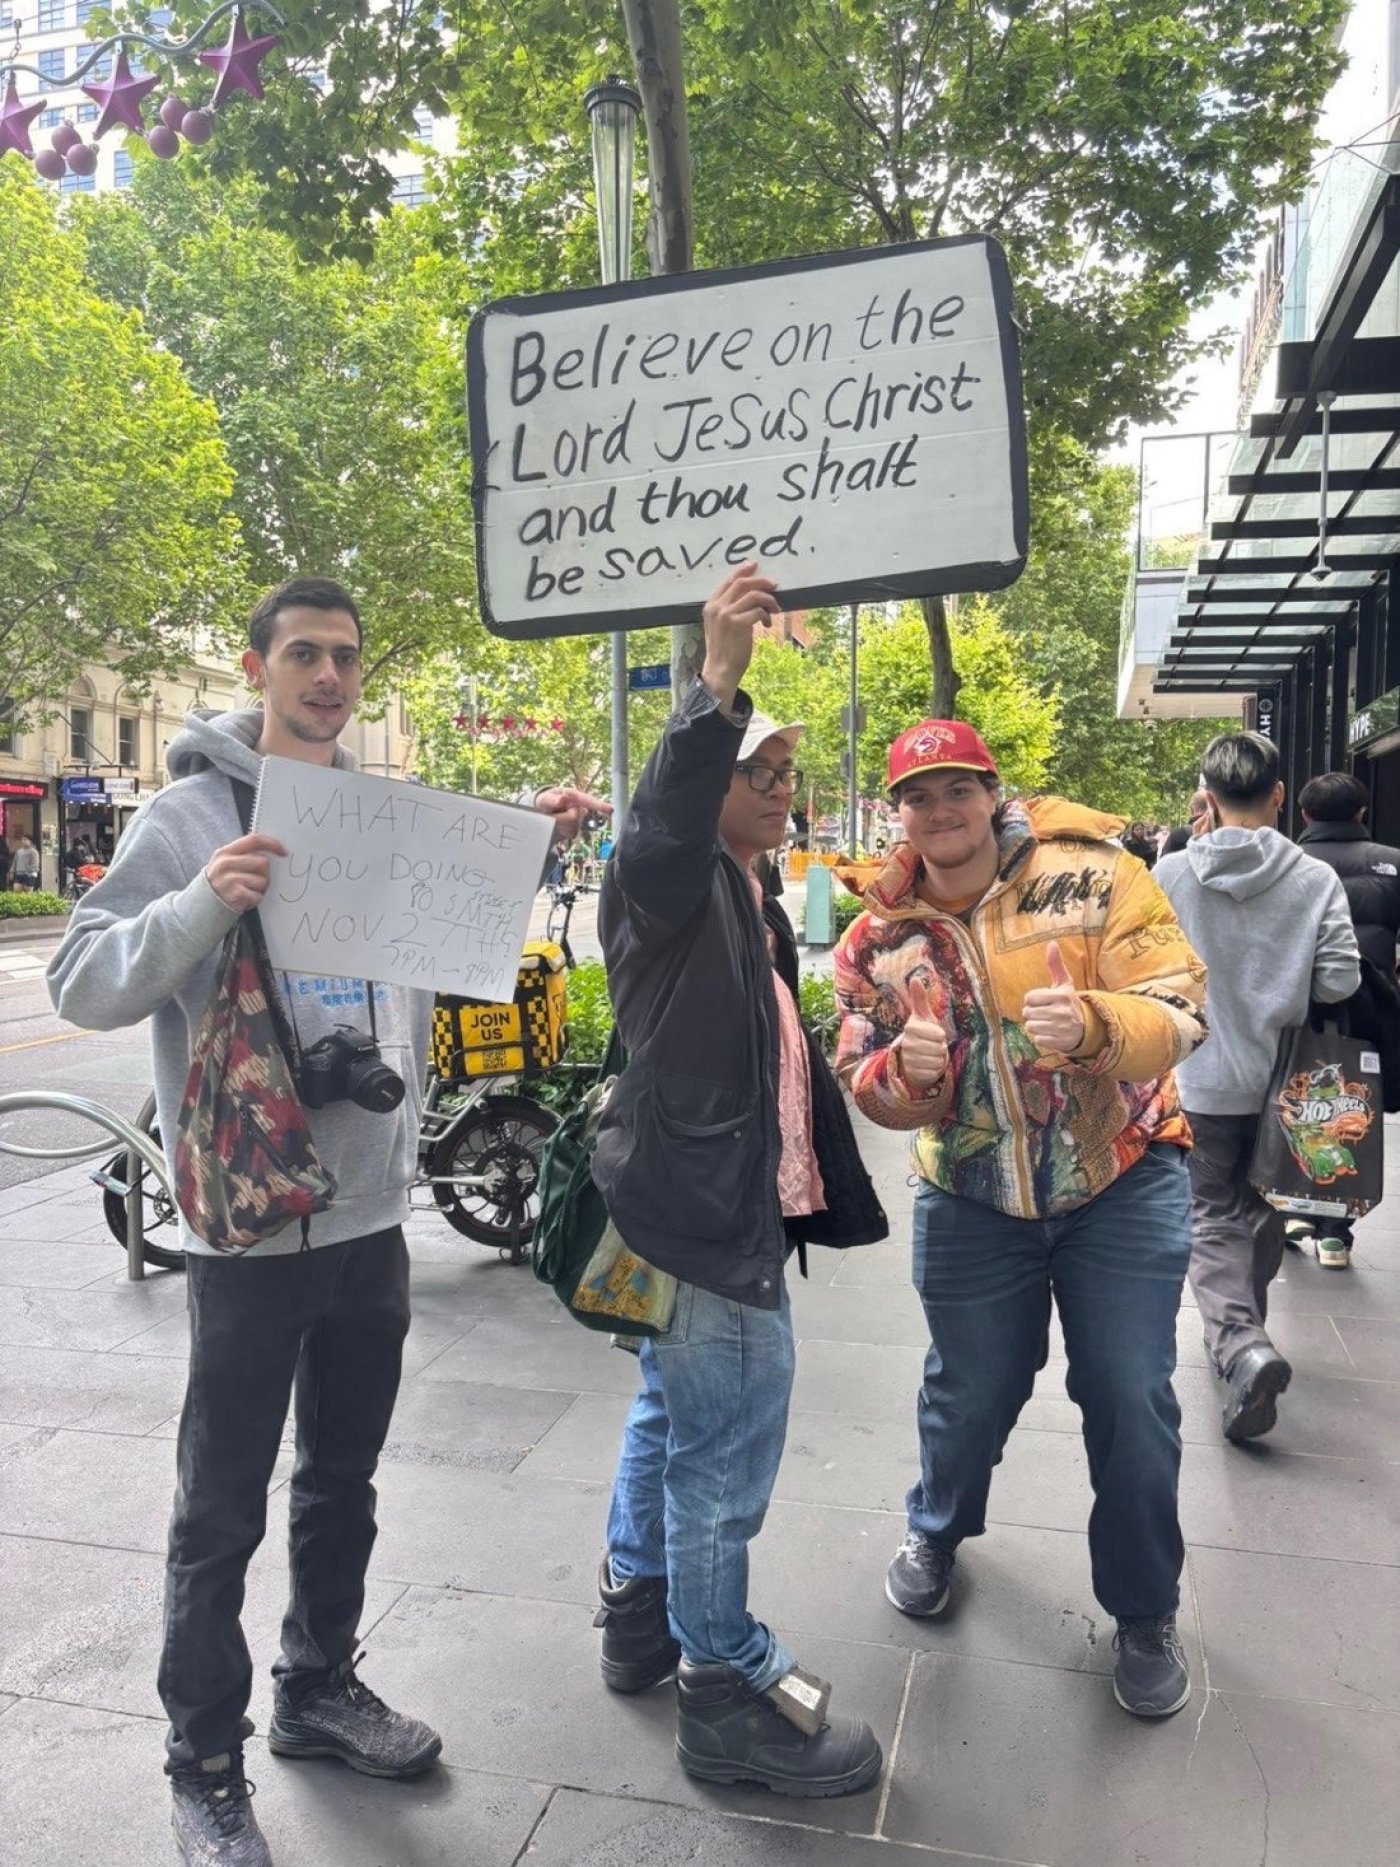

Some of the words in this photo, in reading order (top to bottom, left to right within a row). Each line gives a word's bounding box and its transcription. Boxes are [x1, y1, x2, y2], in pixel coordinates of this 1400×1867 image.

[511, 324, 754, 406] Believe
[770, 323, 832, 366] on
[856, 289, 964, 350] the
[512, 399, 636, 483] Lord
[825, 361, 981, 432] Christ
[519, 487, 616, 546] and
[637, 477, 749, 525] thou
[777, 434, 917, 500] shalt
[526, 556, 585, 601] be
[598, 517, 816, 582] saved.
[293, 785, 443, 833] WHAT
[443, 814, 523, 850] ARE
[279, 851, 370, 903] YOU
[389, 852, 496, 888] DOING
[291, 908, 385, 944] NOV
[380, 945, 436, 978] 7PM
[470, 1012, 511, 1028] JOIN
[481, 1028, 504, 1041] US
[1299, 1100, 1335, 1121] HOT
